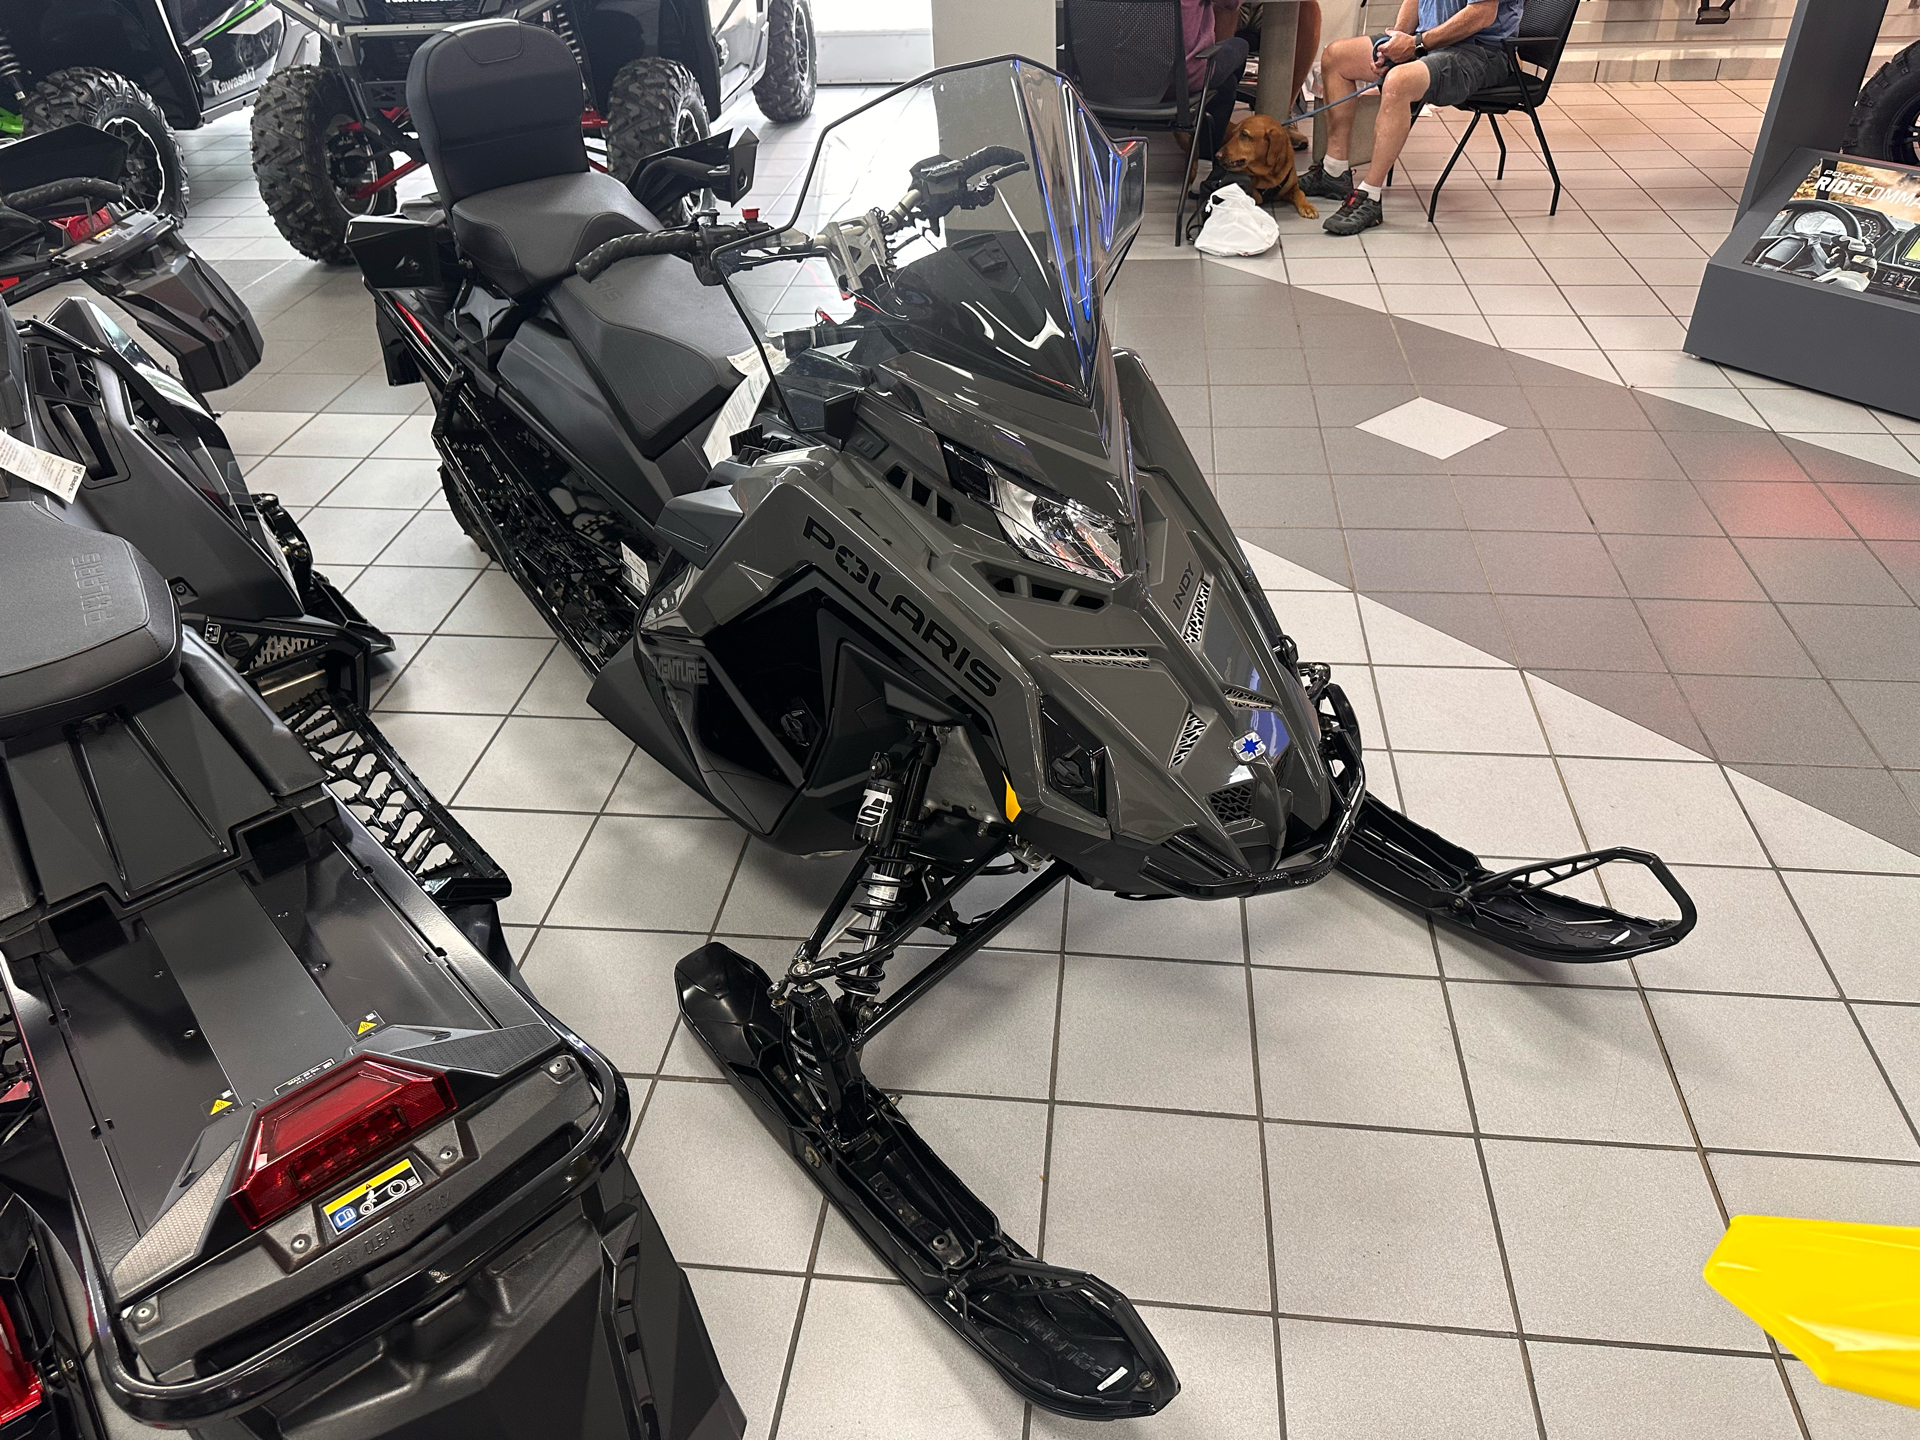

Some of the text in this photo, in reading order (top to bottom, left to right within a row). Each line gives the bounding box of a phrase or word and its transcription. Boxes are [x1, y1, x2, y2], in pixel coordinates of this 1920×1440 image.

[212, 66, 256, 96] Kawasaki
[1823, 169, 1875, 184] POLARIS
[71, 552, 115, 627] POLARIS
[802, 515, 1002, 698] POLARIS
[1172, 560, 1194, 611] INDY
[643, 655, 709, 685] VENTURE
[364, 1224, 399, 1255] CLEAR
[401, 1213, 415, 1232] OF
